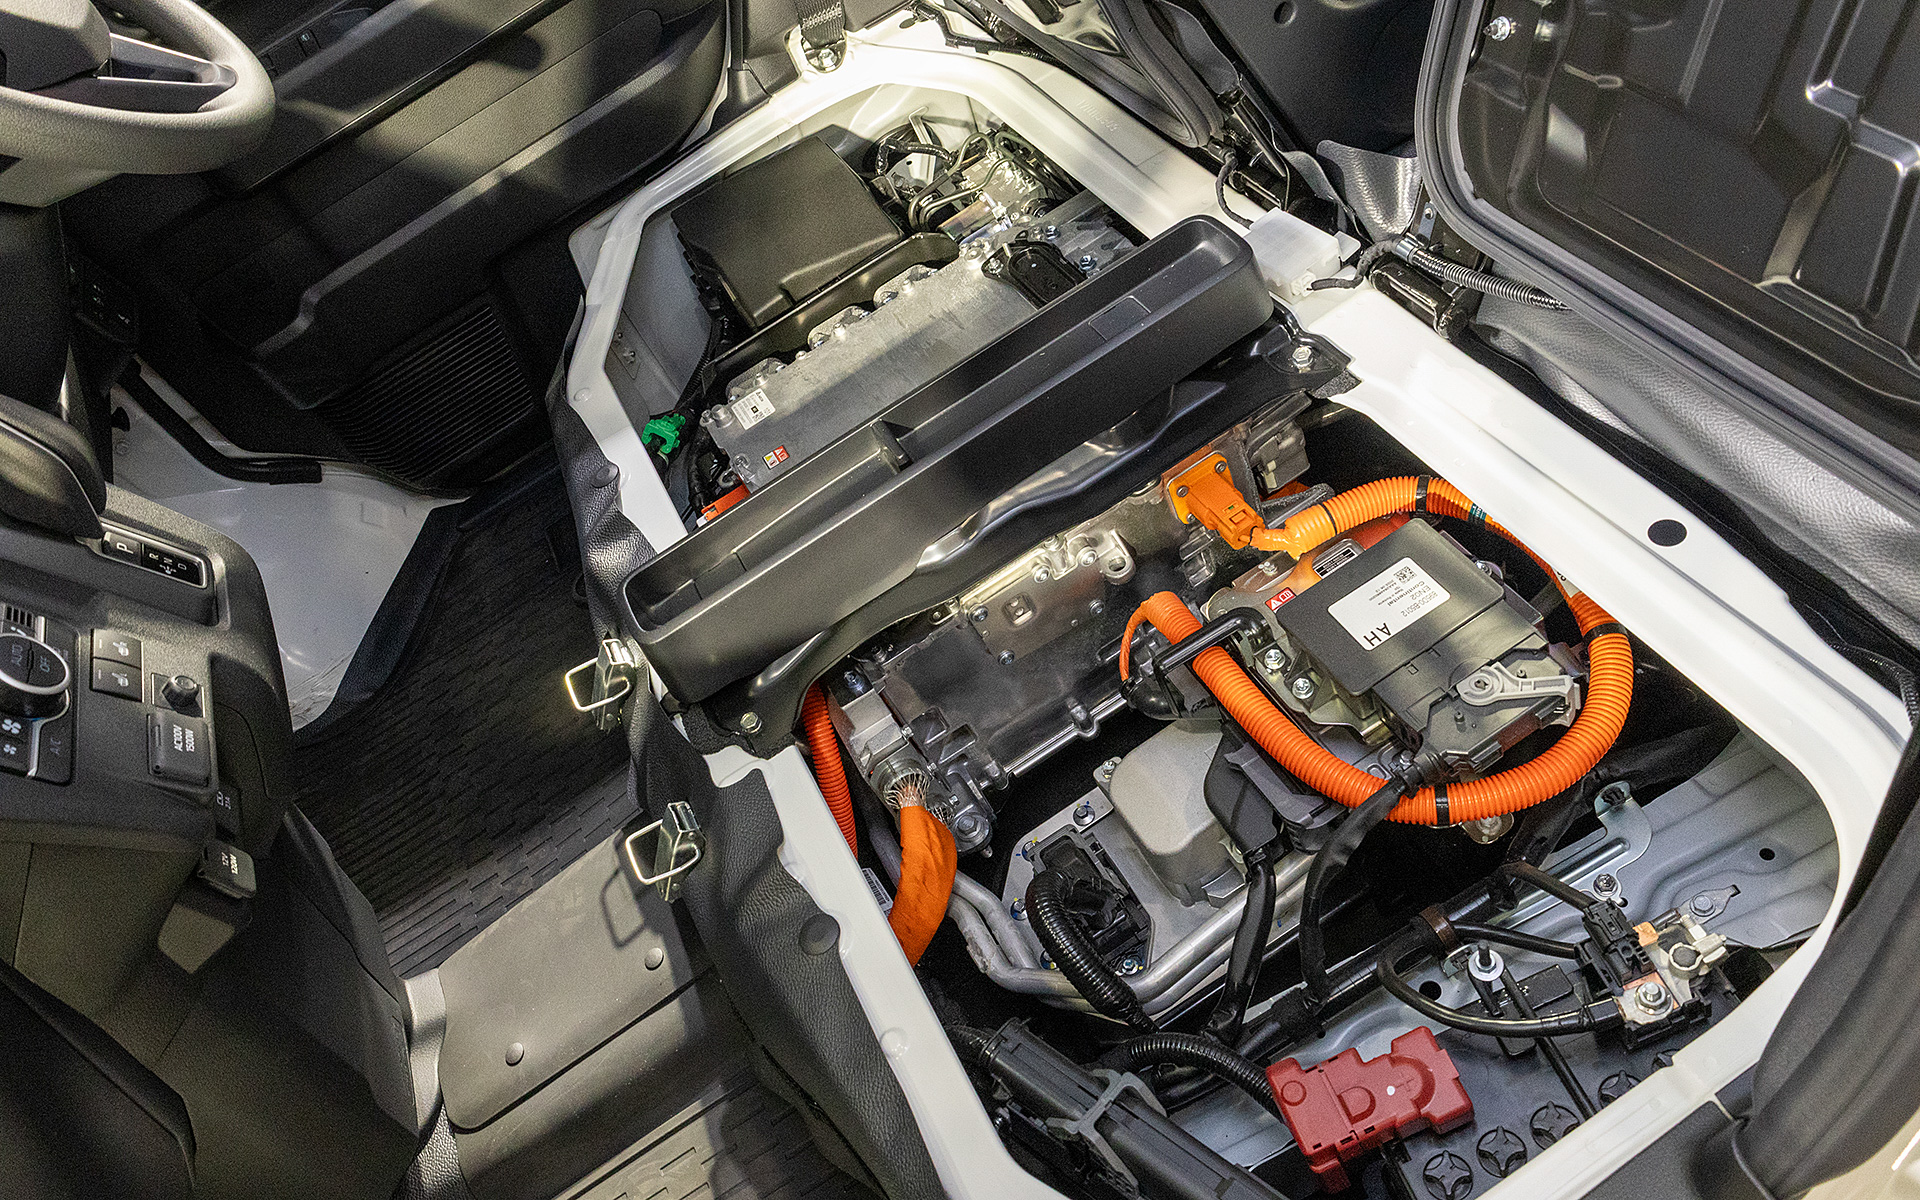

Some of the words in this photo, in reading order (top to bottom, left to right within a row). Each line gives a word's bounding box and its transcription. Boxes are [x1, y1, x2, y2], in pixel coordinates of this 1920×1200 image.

[116, 542, 134, 555] P
[149, 552, 160, 561] R
[163, 557, 173, 566] N
[177, 563, 187, 571] D
[1387, 580, 1426, 607] Continental
[1363, 622, 1392, 647] AH
[40, 655, 51, 674] OFF
[49, 736, 62, 756] A/C
[173, 724, 183, 752] AC100V
[185, 728, 195, 752] 1500W
